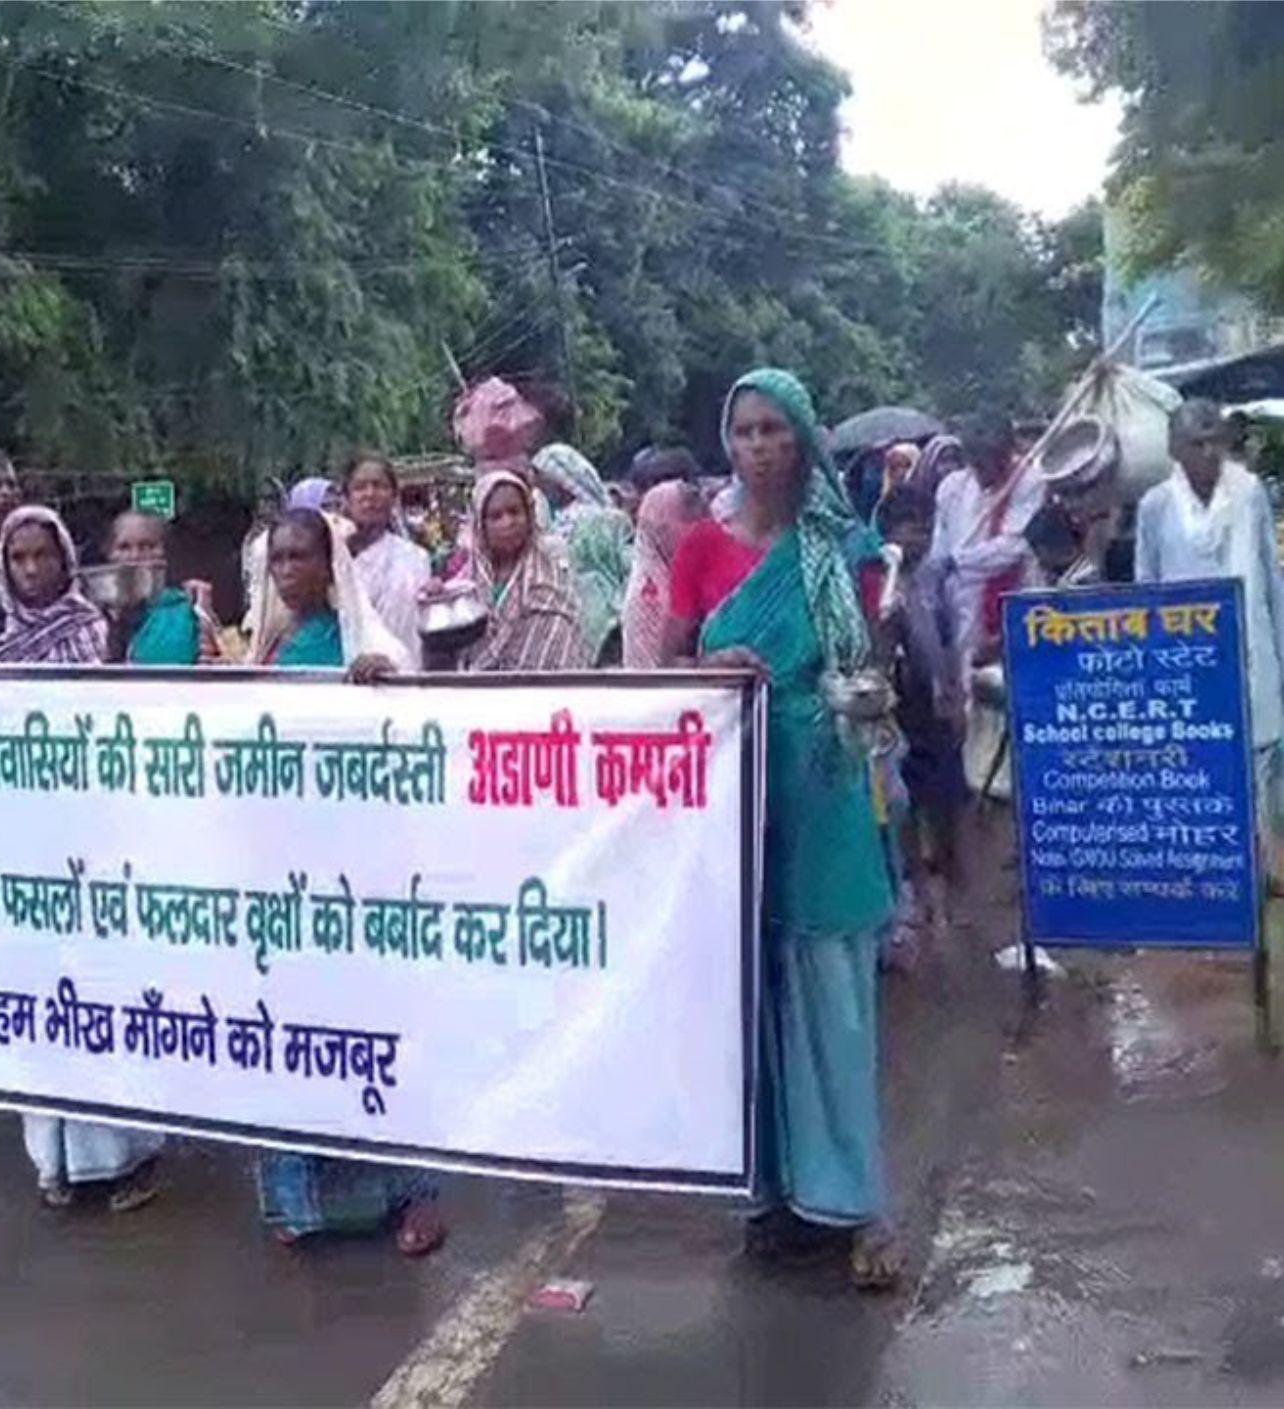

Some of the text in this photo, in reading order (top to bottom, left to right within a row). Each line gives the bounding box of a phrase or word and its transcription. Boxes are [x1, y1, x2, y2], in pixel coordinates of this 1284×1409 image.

[1023, 602, 1221, 647] किताब घर
[1023, 722, 1088, 743] School
[1171, 720, 1235, 741] Books
[96, 712, 136, 795] की
[143, 712, 206, 799] सारी
[212, 712, 305, 800] जमीन
[468, 708, 581, 808] अडाणी
[591, 711, 712, 809] कम्पनी
[1043, 769, 1156, 792] Competition
[1032, 797, 1087, 815] Bihar
[1, 857, 87, 934] फसलों
[89, 861, 131, 938] एवं
[135, 881, 240, 946] फलदार
[244, 872, 308, 975] वृक्षों
[310, 875, 356, 956] को
[362, 873, 445, 961] बर्बाद
[452, 901, 510, 965] कर
[46, 976, 115, 1054] भीख
[123, 987, 218, 1067] माँगने
[226, 1000, 274, 1074] को
[283, 1022, 400, 1115] मजबूर
